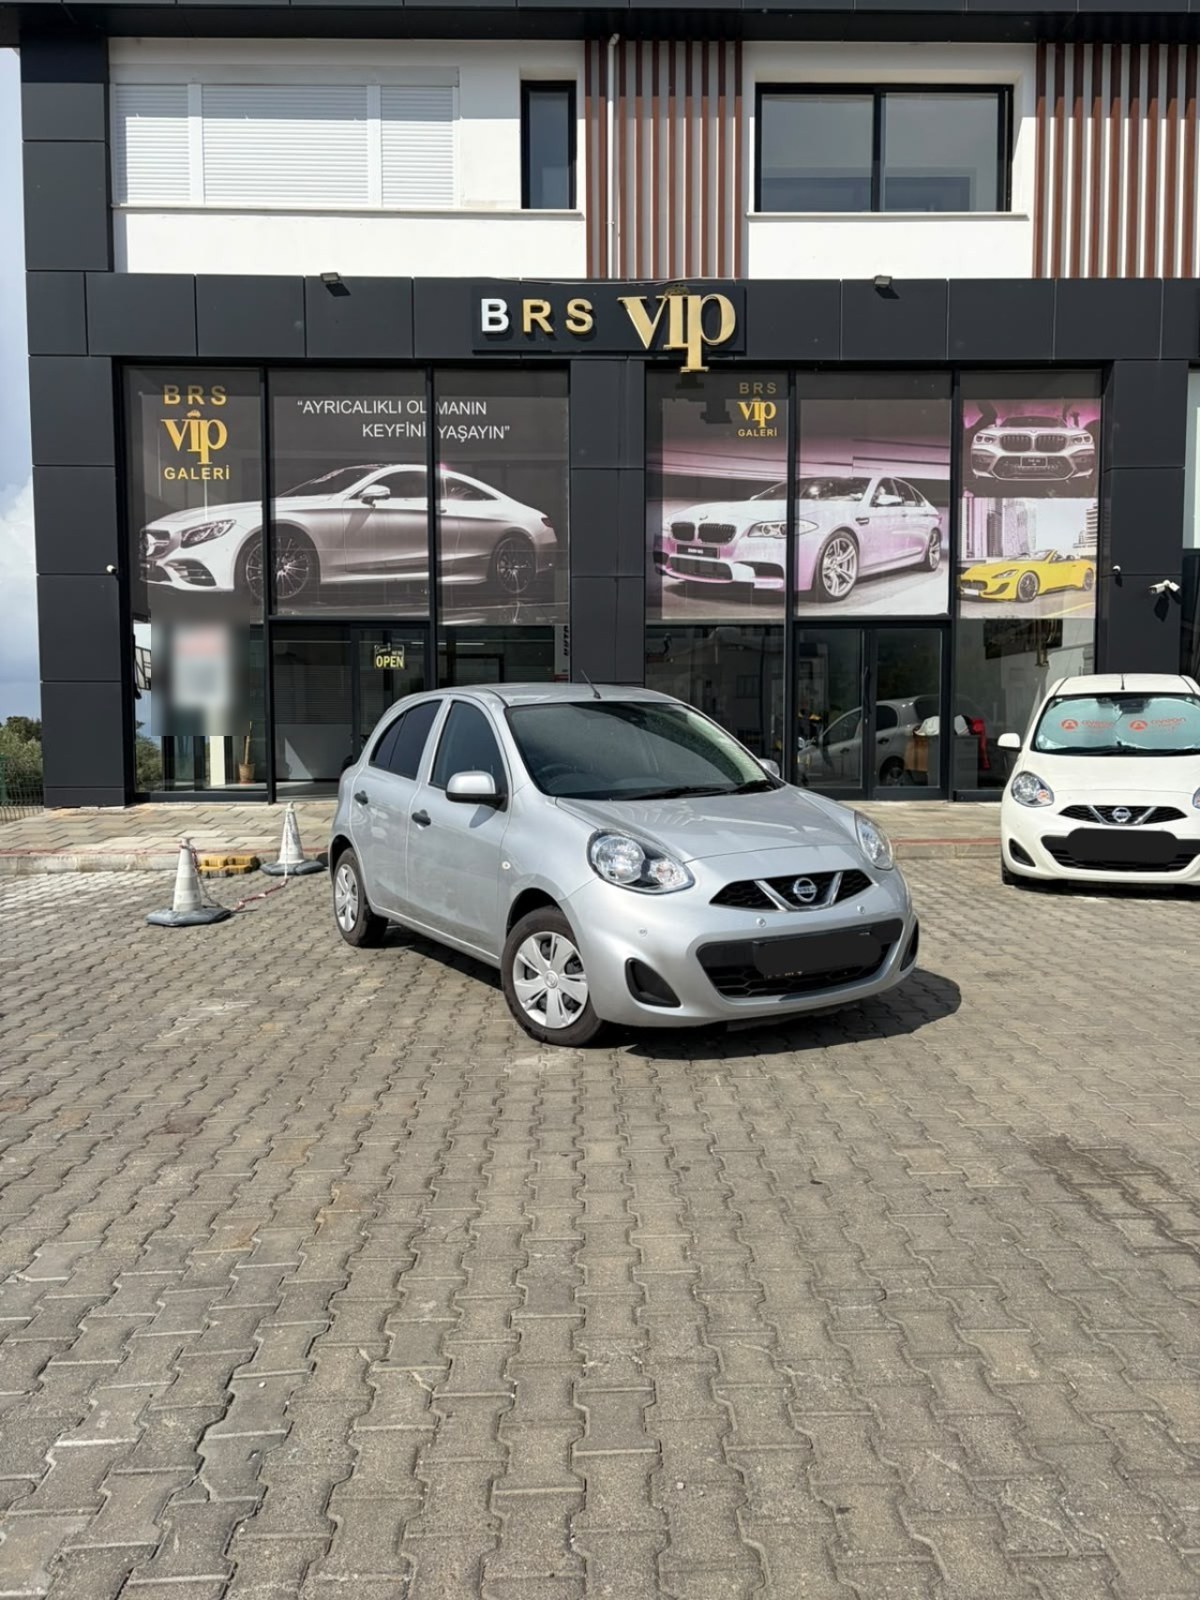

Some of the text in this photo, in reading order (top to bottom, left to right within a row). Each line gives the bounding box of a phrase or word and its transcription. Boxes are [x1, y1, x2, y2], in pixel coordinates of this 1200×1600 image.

[480, 298, 594, 334] BRS
[163, 384, 227, 406] BRS
[739, 382, 777, 395] BRS
[362, 421, 426, 438] KEYFİNİ
[737, 427, 778, 437] GALERİ
[164, 464, 230, 480] GALERİ
[376, 655, 404, 668] OPEN
